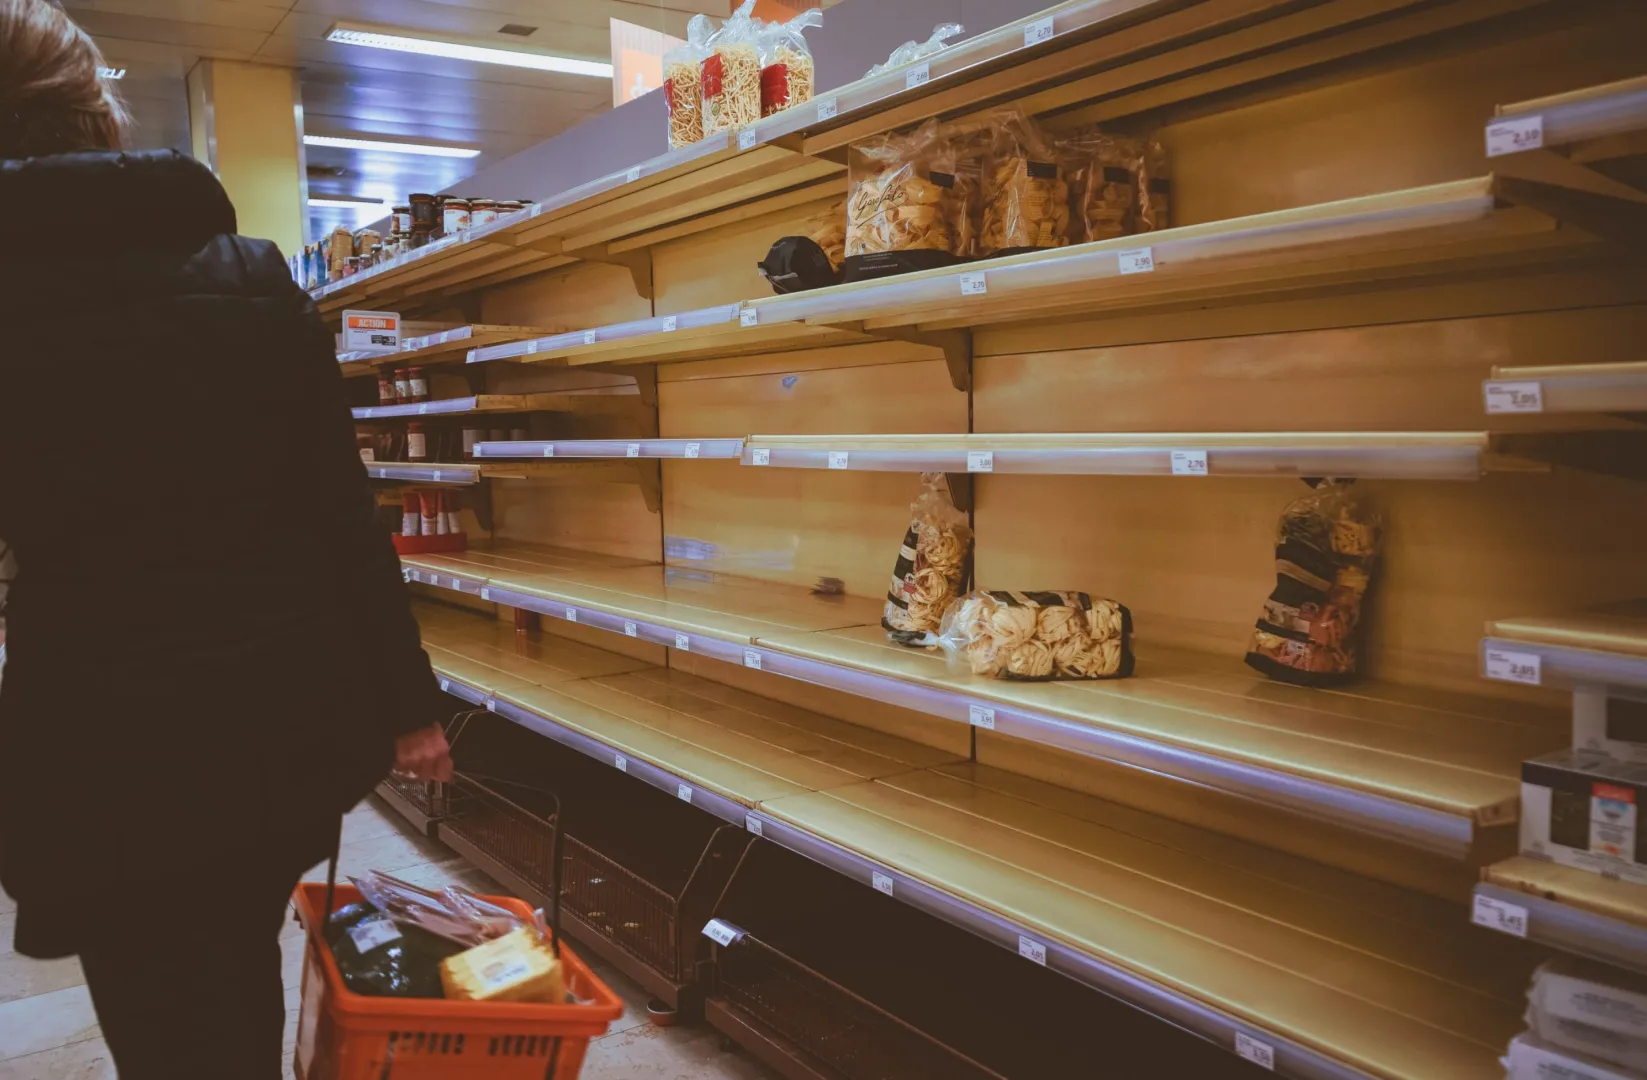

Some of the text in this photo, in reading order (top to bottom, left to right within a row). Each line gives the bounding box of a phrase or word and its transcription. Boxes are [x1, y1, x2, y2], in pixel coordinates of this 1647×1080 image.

[1037, 26, 1051, 38] 2.70
[1135, 256, 1151, 266] 2.90
[972, 280, 985, 289] 2.70
[358, 319, 386, 328] ACTION
[979, 459, 992, 467] 3.00
[1187, 459, 1205, 468] 2.70
